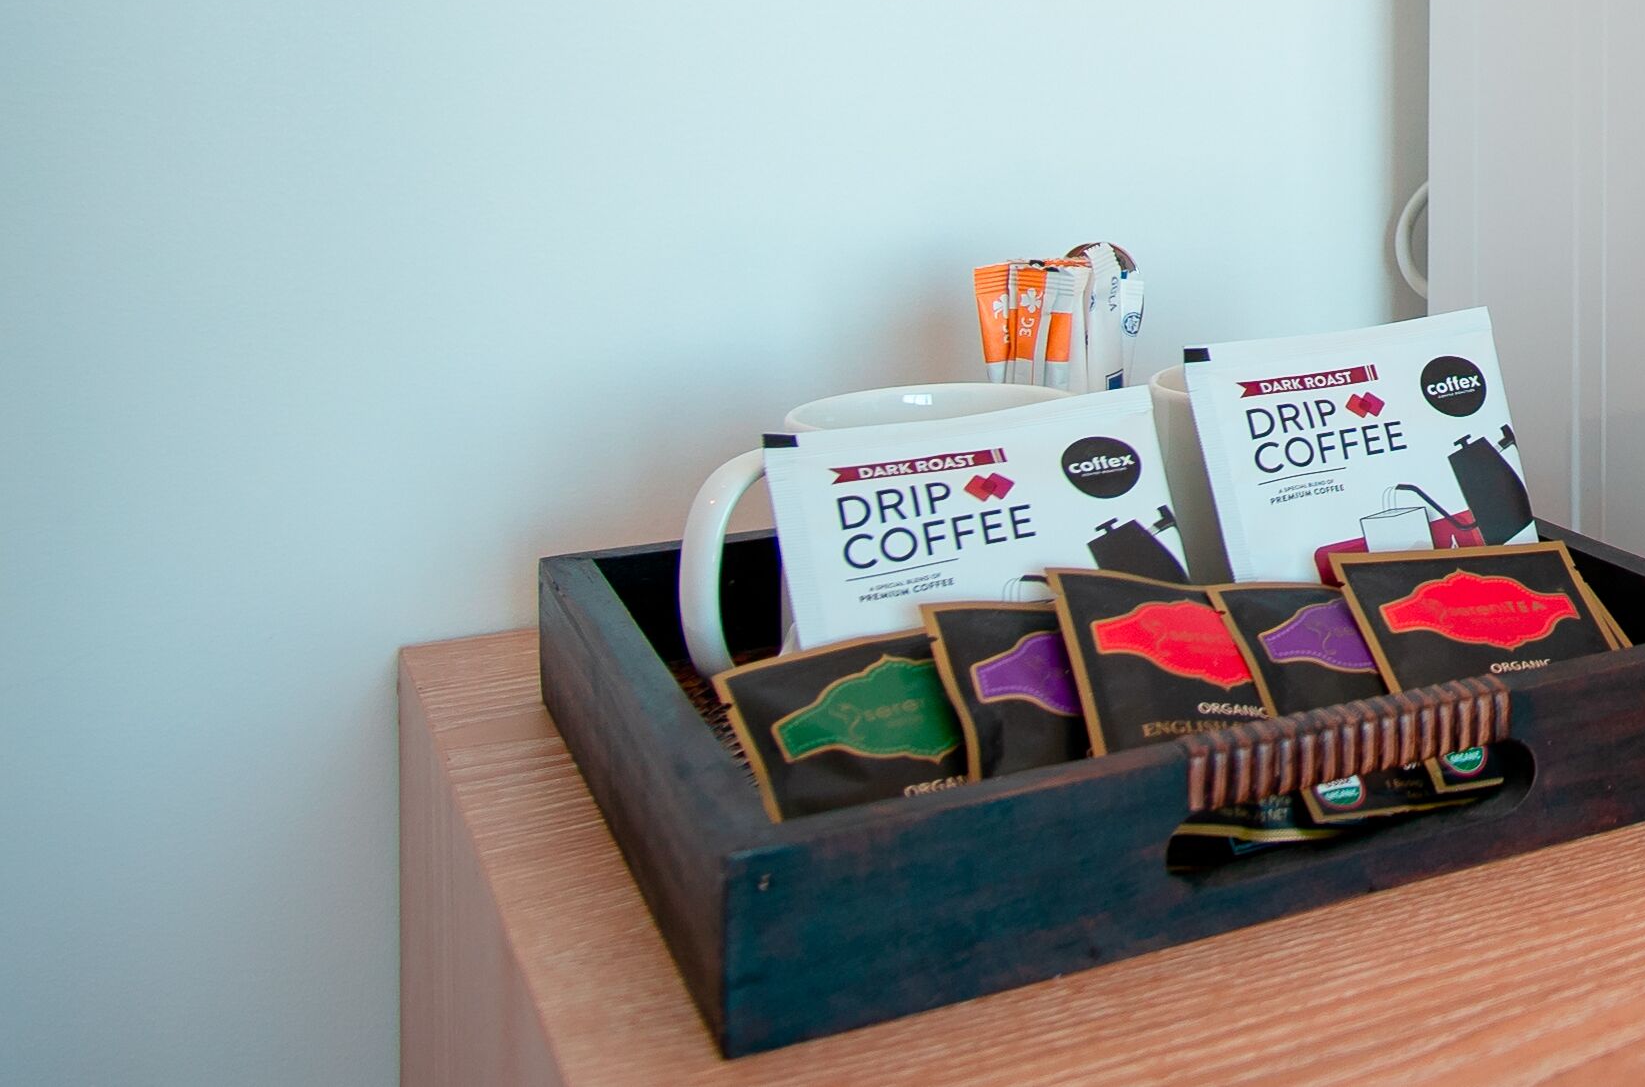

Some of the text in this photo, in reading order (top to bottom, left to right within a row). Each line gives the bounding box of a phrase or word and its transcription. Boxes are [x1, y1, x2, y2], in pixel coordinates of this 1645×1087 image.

[1259, 371, 1352, 394] DARK ROAST
[1426, 373, 1482, 396] coffex
[1245, 398, 1337, 440] DRIP
[1254, 420, 1408, 474] COFFEE
[857, 454, 976, 480] DARK ROAST
[1067, 453, 1136, 475] coffex
[836, 481, 952, 530] DRIP
[1270, 484, 1345, 505] PREMIUM COFFEE
[842, 503, 1037, 570] COFFEE
[858, 577, 956, 602] PREMIUM COFFEE
[1197, 701, 1268, 720] ORGANIC
